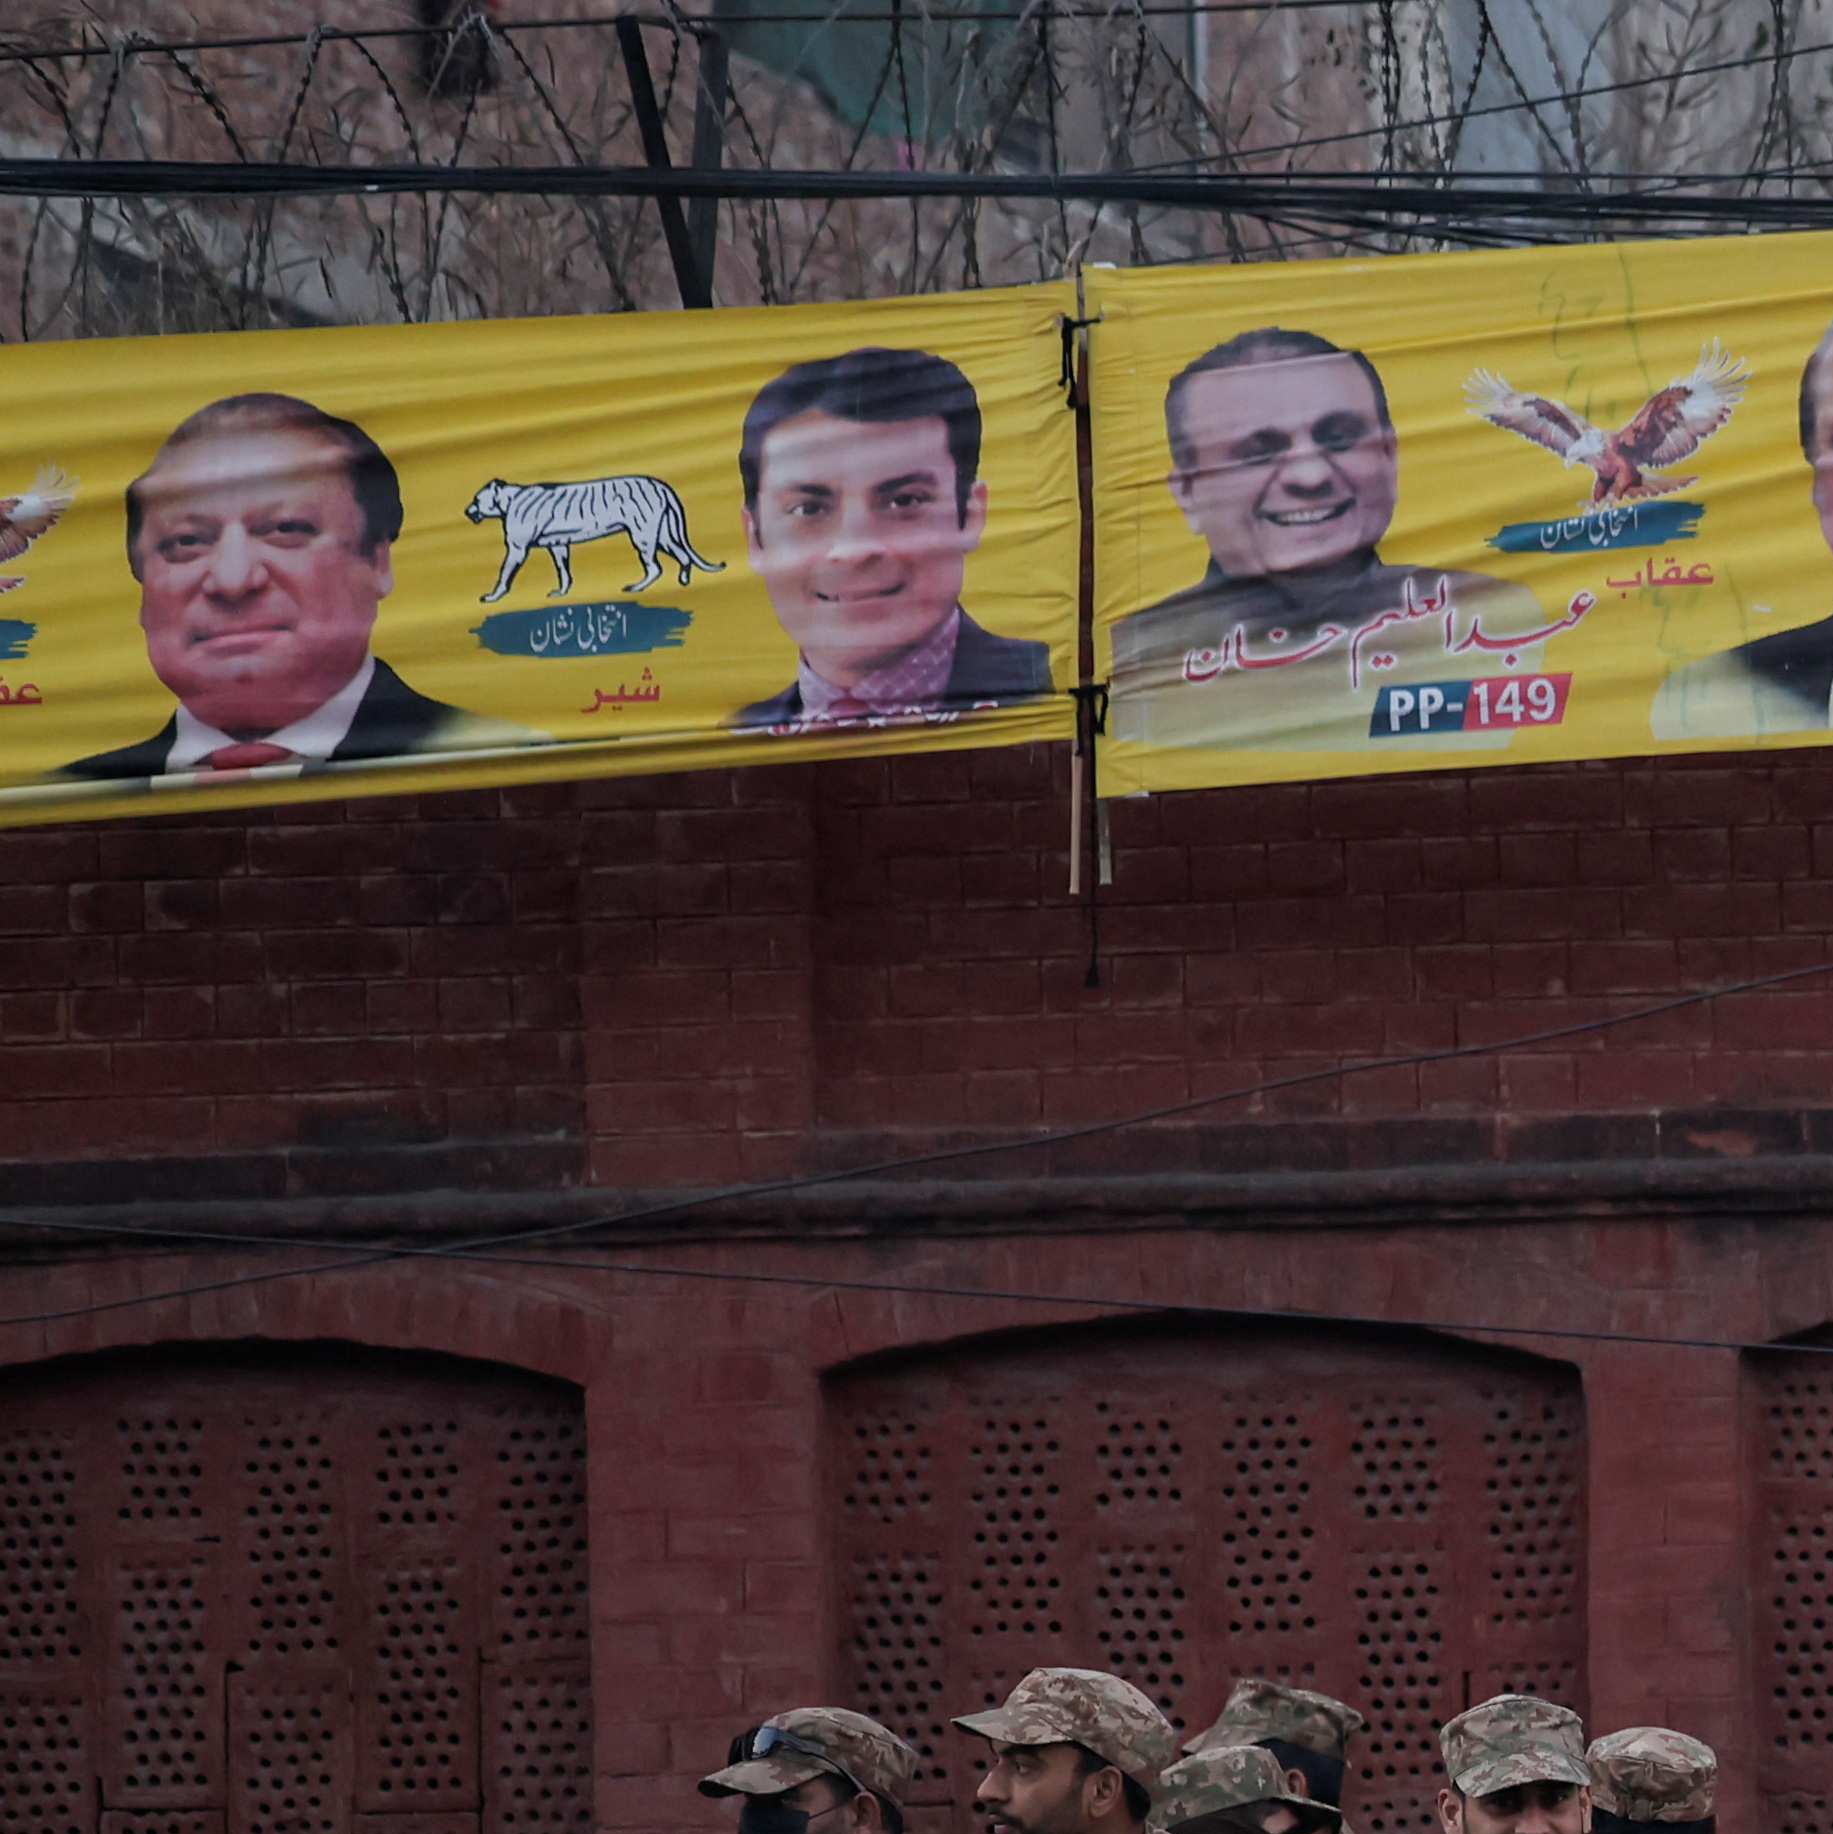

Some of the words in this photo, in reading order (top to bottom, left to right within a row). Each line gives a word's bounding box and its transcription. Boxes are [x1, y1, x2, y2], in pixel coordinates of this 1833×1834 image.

[1606, 557, 1714, 600] عقاب
[530, 606, 575, 652] نشان
[576, 603, 627, 653] انتخابی
[1181, 624, 1348, 683] خان
[580, 666, 661, 714] شیر
[1388, 678, 1557, 732] PP-149
